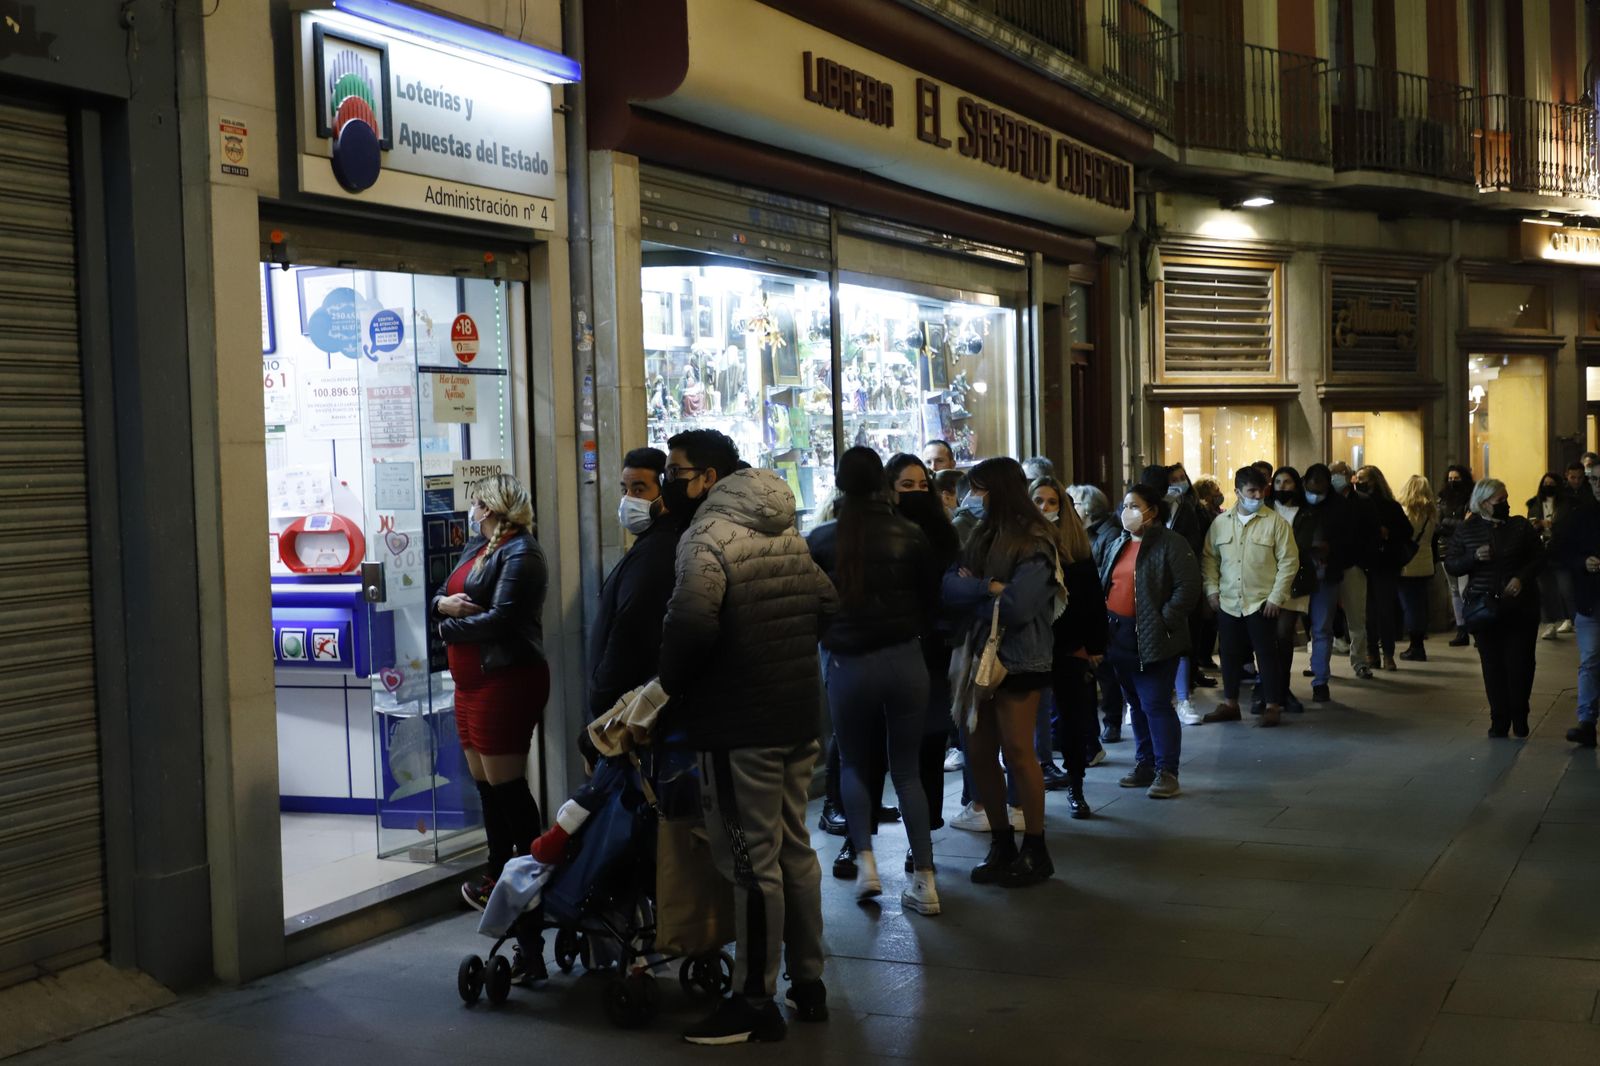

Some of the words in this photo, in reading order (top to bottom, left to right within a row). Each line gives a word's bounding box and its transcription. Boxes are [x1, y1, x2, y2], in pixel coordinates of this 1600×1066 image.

[396, 74, 461, 113] Loterías
[465, 98, 473, 121] y
[398, 122, 472, 159] Apuestas
[476, 139, 498, 166] del
[501, 145, 549, 176] Estado
[802, 51, 894, 128] LIBRERIA
[916, 77, 952, 149] EL
[957, 96, 1051, 183] SAGRADO
[1057, 138, 1131, 211] CORAZON
[425, 185, 518, 218] Administración
[540, 205, 548, 222] 4
[455, 318, 472, 335] +18
[374, 387, 405, 396] BOTES
[469, 465, 502, 476] PREMIO
